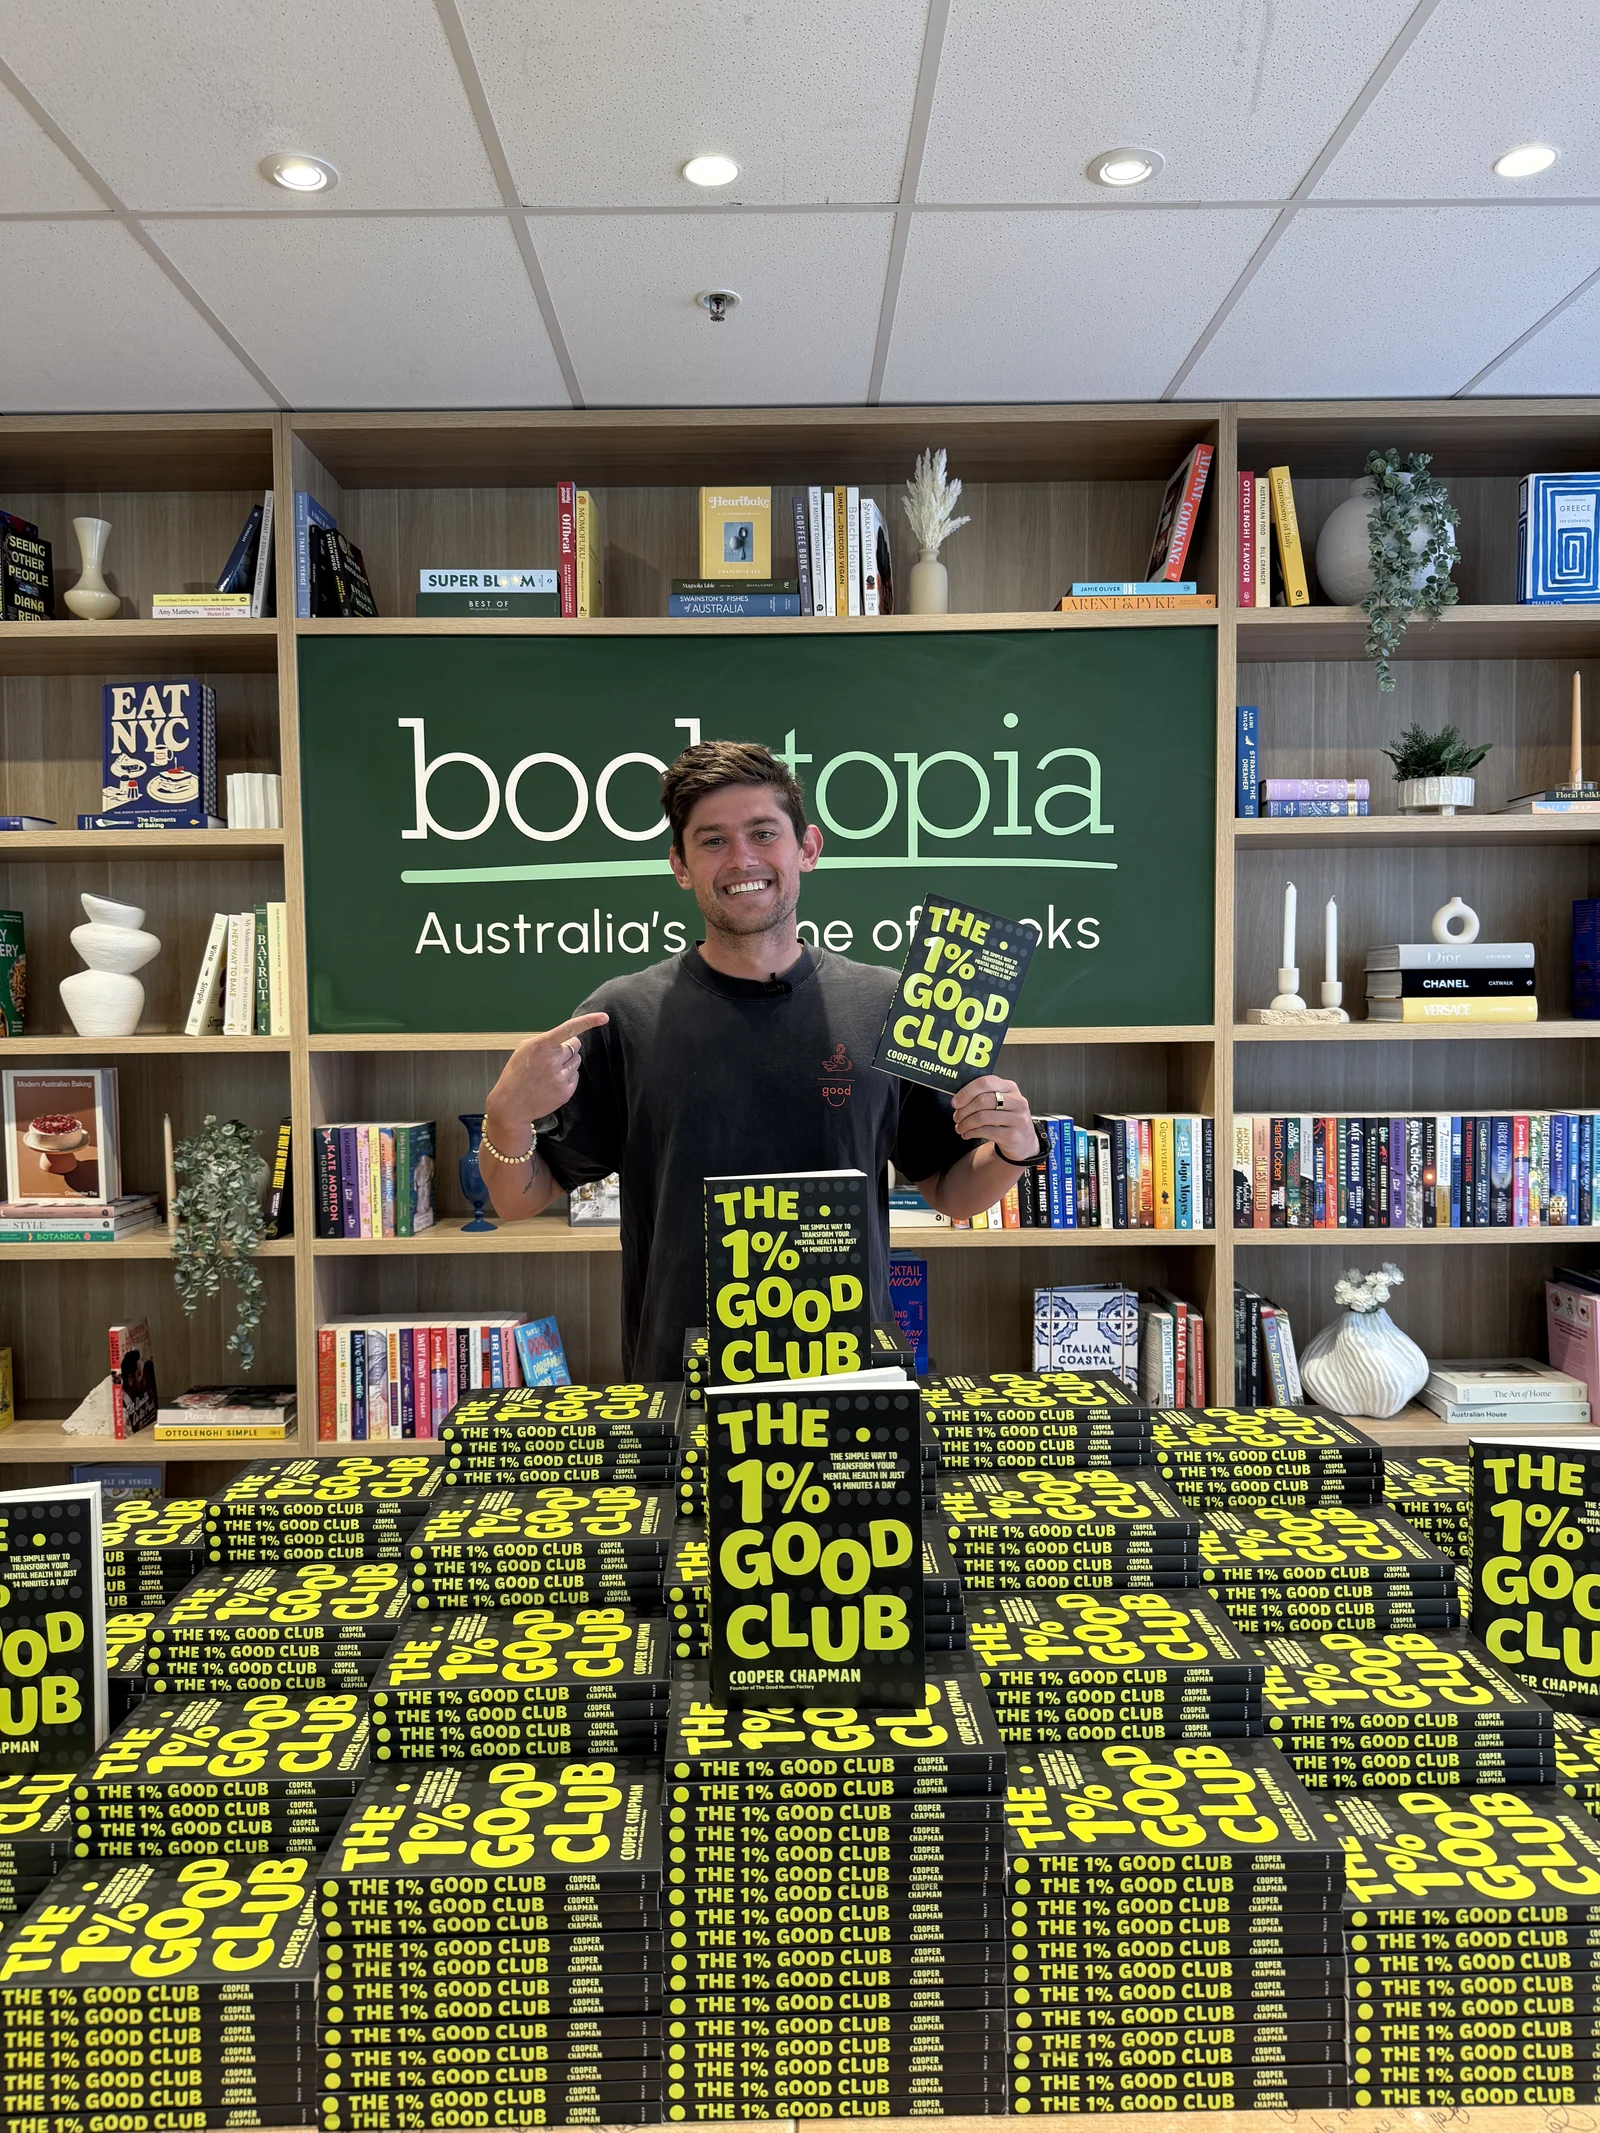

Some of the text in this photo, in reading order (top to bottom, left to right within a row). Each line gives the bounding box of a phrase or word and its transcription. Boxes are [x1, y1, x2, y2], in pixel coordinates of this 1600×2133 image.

[709, 496, 770, 508] Heartbake
[1169, 452, 1212, 565] ALPINE COOKING
[9, 535, 45, 556] SEEING
[562, 514, 572, 554] Offbeat
[797, 516, 806, 546] COFFEE
[849, 507, 858, 580] Beach House
[11, 552, 44, 571] OTHER
[799, 548, 807, 569] BOOK
[9, 565, 49, 587] PEOPLE
[428, 574, 479, 587] SUPER
[1123, 583, 1137, 594] ONE
[15, 594, 44, 612] DIANA
[18, 607, 41, 621] REID
[684, 603, 744, 614] of AUSTRALIA
[111, 684, 190, 720] EAT
[111, 718, 190, 754] NYC
[398, 712, 1115, 858] bootopia
[415, 908, 687, 954] Australia's
[928, 906, 990, 946] THE
[924, 936, 975, 980] 1%
[1427, 951, 1460, 964] Dior
[1423, 979, 1469, 989] CHANEL
[903, 972, 1009, 1030] GOOD
[1423, 1004, 1472, 1016] VERSACE
[893, 1014, 993, 1068] CLUB
[887, 1049, 917, 1066] COOPER
[919, 1060, 958, 1080] CHAPMAN
[822, 1084, 851, 1097] good
[1274, 1120, 1283, 1181] Harlan Coben
[1351, 1123, 1359, 1182] KATE ATKINSON
[1411, 1121, 1420, 1178] GINA CHICK
[1426, 1123, 1434, 1166] Anita Heiss
[321, 1155, 329, 1212] HOMECOMING
[327, 1145, 338, 1221] KATE MORTON
[1180, 1160, 1190, 1216] Jojo Moyes
[714, 1186, 799, 1225] THE
[13, 1221, 45, 1230] STYLE
[722, 1230, 800, 1278] 1%
[716, 1275, 862, 1329] GOOD
[1062, 1344, 1111, 1354] ITALIAN
[1178, 1318, 1186, 1361] SALATA
[460, 1335, 469, 1389] broken brains
[721, 1331, 861, 1382] CLUB
[1058, 1355, 1115, 1366] COASTAL
[1272, 1352, 1283, 1382] Baker's
[492, 1361, 500, 1383] LEE
[1277, 1385, 1286, 1406] Book
[1522, 1390, 1529, 1398] of
[461, 1425, 597, 1439] THE 1% GOOD CLUB
[717, 1402, 829, 1454] THE
[832, 1462, 874, 1470] TRANSFORM
[845, 1452, 869, 1460] SIMPLE
[823, 1472, 850, 1480] MENTAL
[889, 1471, 905, 1479] JUST
[882, 1481, 896, 1489] DAY
[727, 1459, 830, 1523] 1%
[720, 1519, 913, 1595] GOOD
[1222, 1566, 1370, 1581] THE 1% GOOD CLUB
[726, 1592, 910, 1662] CLUB
[729, 1669, 861, 1684] COOPER CHAPMAN
[349, 1875, 546, 1896] THE 1% GOOD CLUB
[565, 1882, 600, 1891] CHAPMAN
[569, 1875, 596, 1883] COOPER
